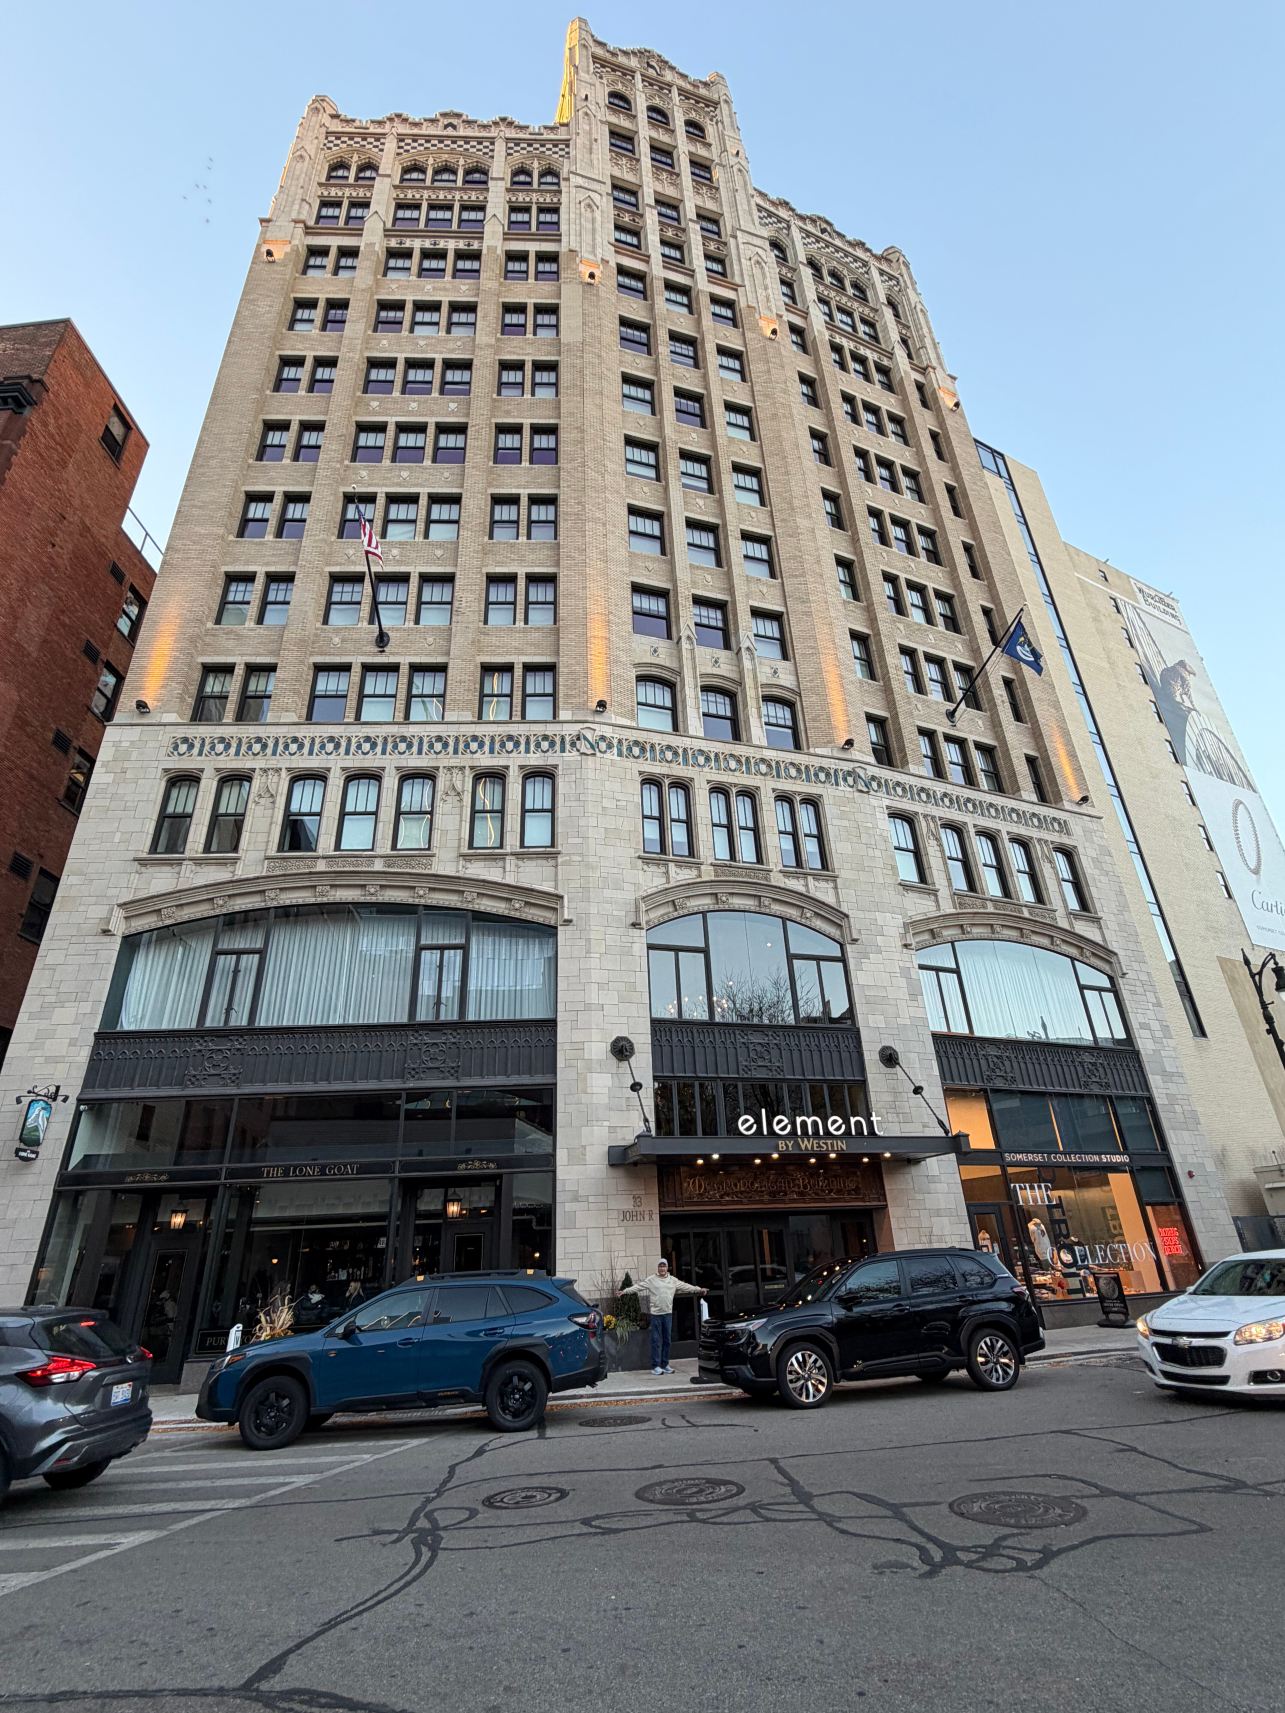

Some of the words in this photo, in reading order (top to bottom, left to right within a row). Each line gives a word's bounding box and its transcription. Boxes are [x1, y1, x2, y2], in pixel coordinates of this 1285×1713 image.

[1251, 889, 1285, 916] Carti
[737, 1107, 884, 1136] element
[778, 1140, 794, 1151] BY
[798, 1137, 847, 1151] WESTIN
[1004, 1153, 1048, 1162] SOMERSET
[1051, 1153, 1100, 1163] COLLECTION
[1101, 1154, 1130, 1163] STUDIO
[261, 1167, 285, 1178] THE
[289, 1165, 322, 1177] LONE
[325, 1164, 360, 1175] GOAT
[632, 1194, 643, 1208] 33
[1010, 1182, 1057, 1206] THE
[621, 1210, 646, 1222] JOHN
[647, 1209, 655, 1222] R
[1046, 1240, 1157, 1268] COLLECTION
